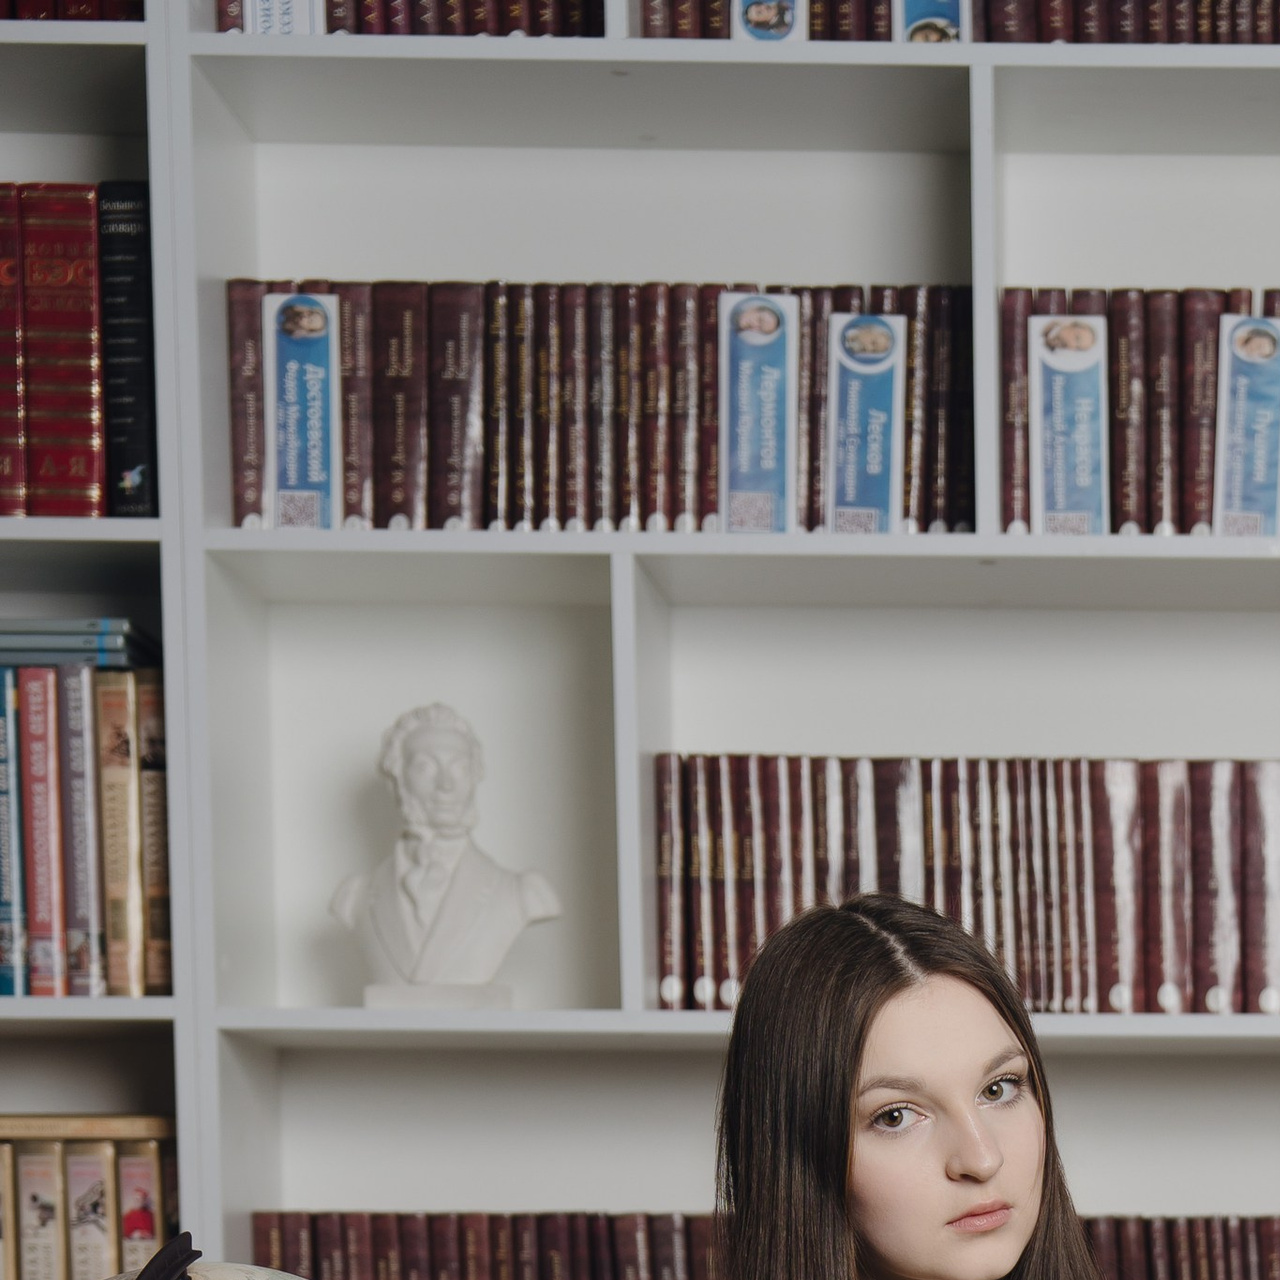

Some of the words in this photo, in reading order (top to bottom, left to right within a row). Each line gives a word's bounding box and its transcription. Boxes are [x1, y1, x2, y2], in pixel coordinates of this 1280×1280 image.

[285, 404, 302, 485] Михайлович
[302, 363, 328, 482] Достоевский
[757, 365, 781, 469] Лермонтов
[867, 408, 888, 475] Лесков
[1072, 397, 1095, 487] Некрасов
[1252, 410, 1273, 482] Пушкин
[24, 680, 45, 735] ДЕТЕЙ
[27, 741, 46, 777] ДЛЯ
[31, 782, 51, 924] ЭНЦИКЛОПЕДИЯ
